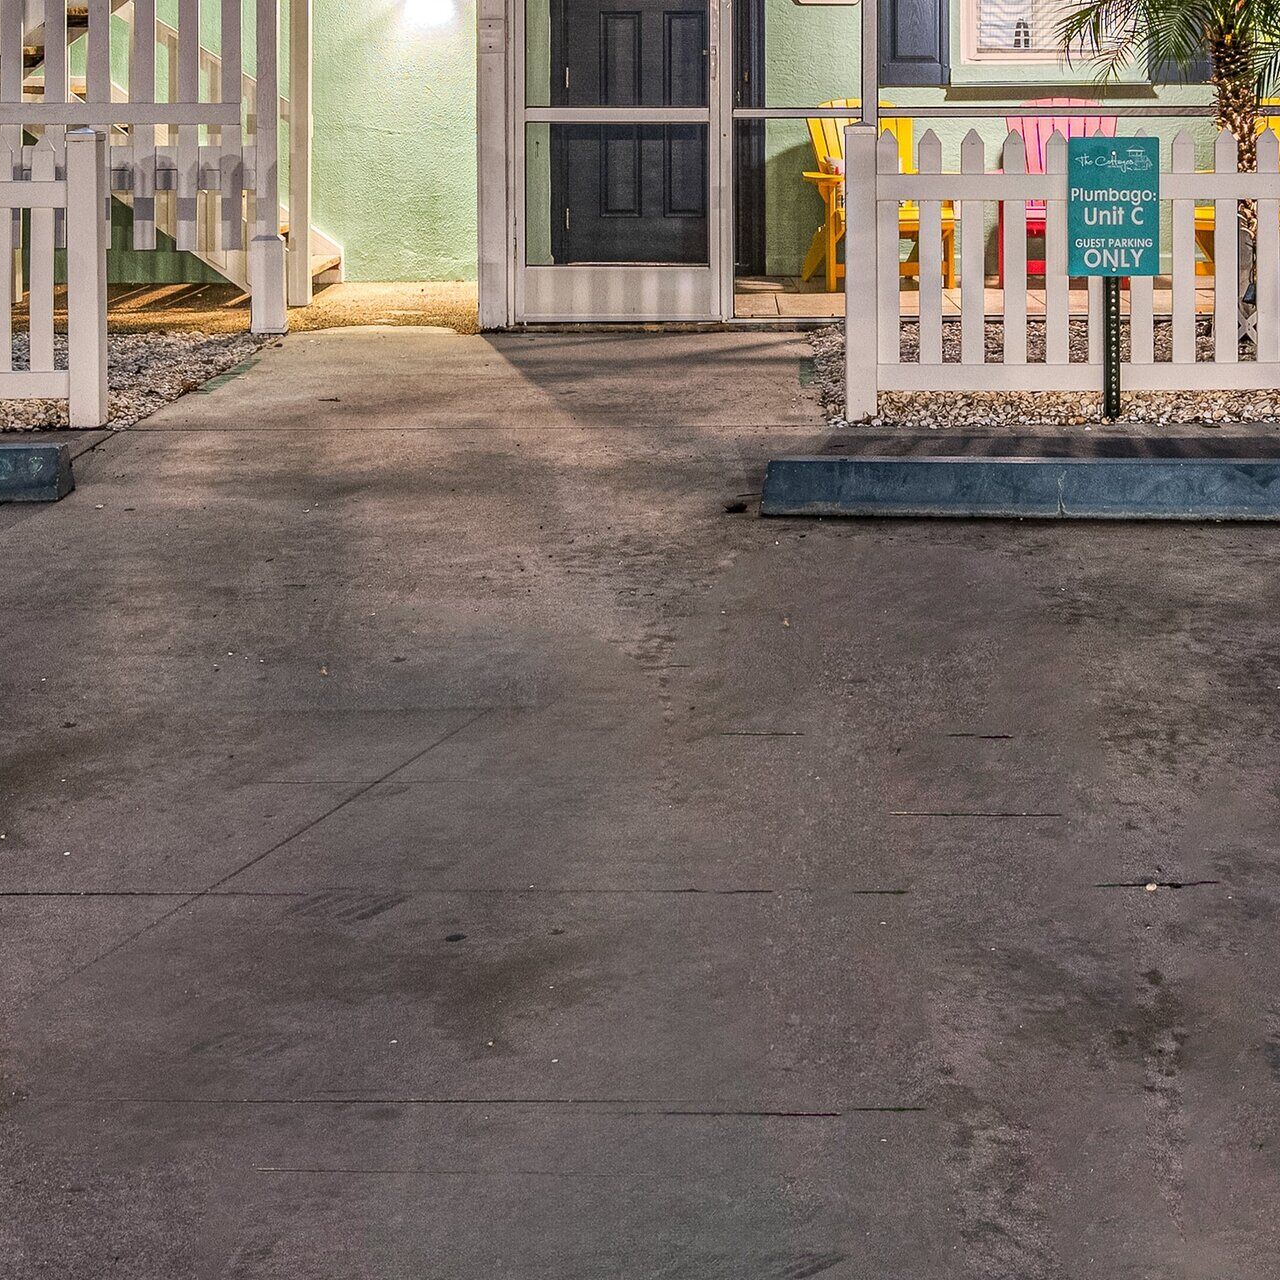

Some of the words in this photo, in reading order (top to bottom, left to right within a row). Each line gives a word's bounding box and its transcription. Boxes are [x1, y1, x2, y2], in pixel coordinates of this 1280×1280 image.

[1075, 154, 1093, 166] The
[1071, 188, 1157, 205] Plumbago:
[1084, 207, 1124, 225] Unit
[1131, 207, 1144, 225] C
[1076, 239, 1105, 247] GUEST
[1109, 239, 1153, 247] PARKING
[1084, 249, 1143, 268] ONLY
